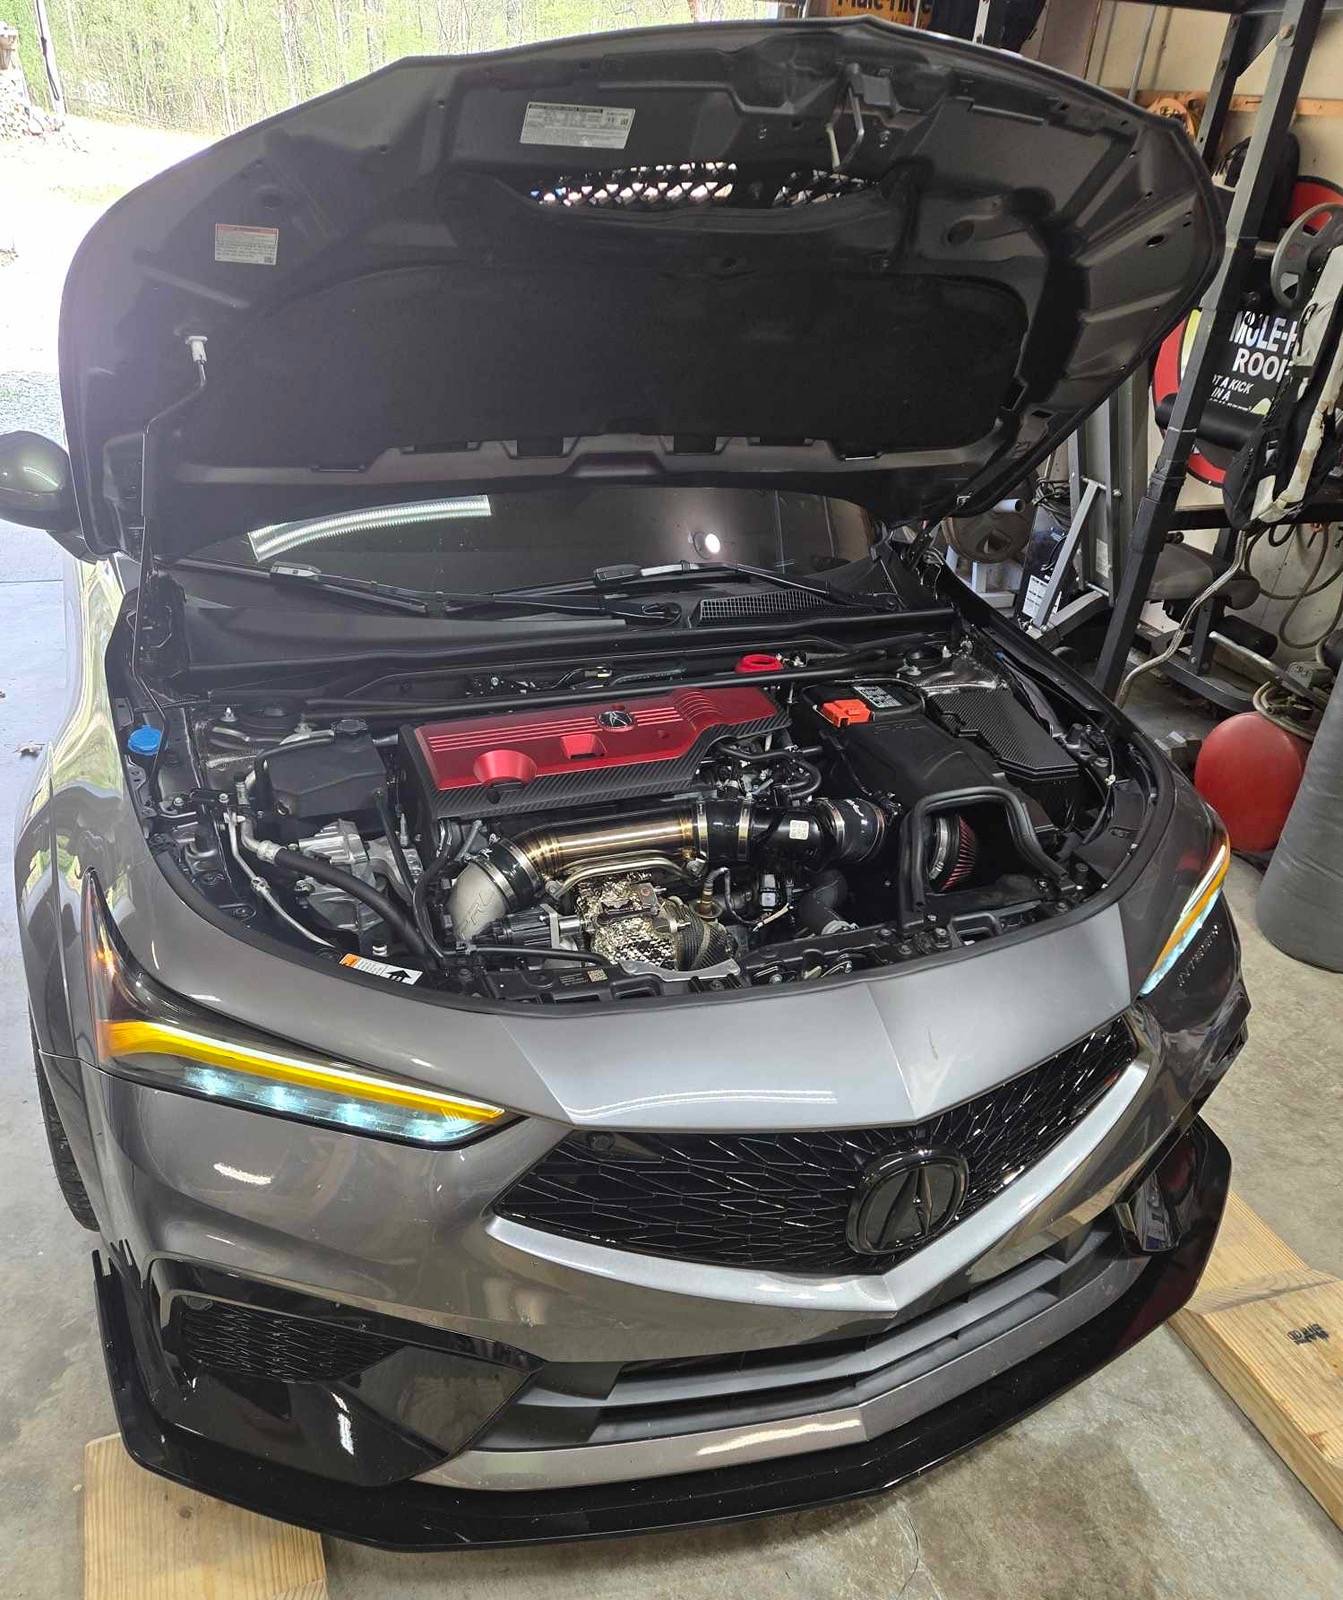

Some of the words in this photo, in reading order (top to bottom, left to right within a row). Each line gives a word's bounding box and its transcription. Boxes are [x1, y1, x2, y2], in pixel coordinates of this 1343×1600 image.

[1220, 376, 1230, 388] A
[1228, 378, 1255, 394] KICK
[1222, 391, 1231, 401] A
